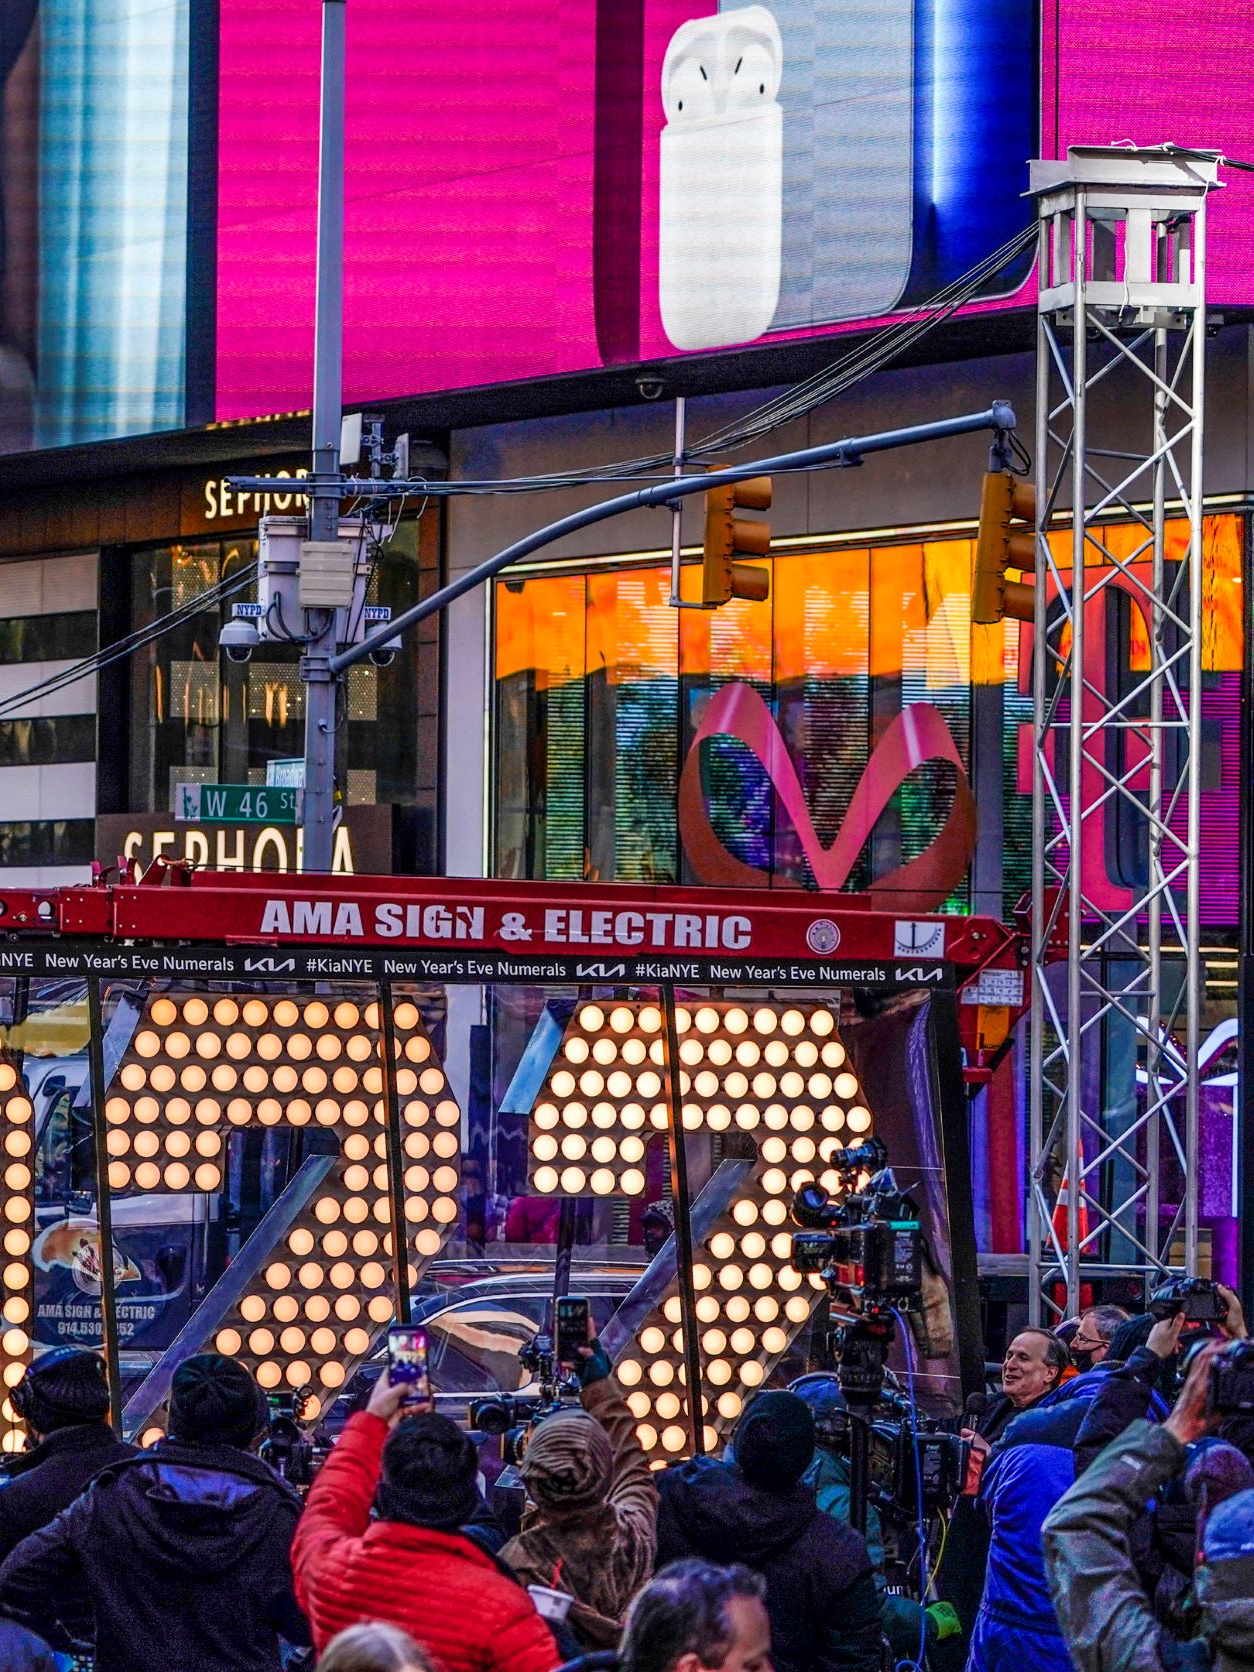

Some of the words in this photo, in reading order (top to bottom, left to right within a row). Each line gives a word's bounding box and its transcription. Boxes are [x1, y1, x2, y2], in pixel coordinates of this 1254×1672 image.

[204, 468, 310, 519] SEPHOR
[237, 605, 262, 616] NYPD
[365, 607, 389, 619] NYPD
[276, 764, 305, 788] Broadwa
[207, 790, 227, 817] W
[239, 791, 268, 818] 46
[280, 792, 295, 809] St
[124, 827, 354, 884] SEPHOA
[260, 900, 364, 936] AMA
[374, 903, 485, 940] SIGN
[499, 912, 533, 941] &
[544, 909, 752, 950] ELECTRIC
[45, 953, 78, 968] New
[83, 954, 128, 969] Year's
[132, 955, 159, 970] Eve
[163, 955, 234, 972] Numerals
[306, 958, 373, 973] #KiaNYE
[384, 960, 417, 974] New
[420, 960, 464, 975] Year's
[467, 961, 494, 975] Eve
[497, 961, 566, 976] Numerals
[635, 963, 699, 978] #KiaNYE
[710, 965, 742, 980] New
[745, 965, 787, 980] Year's
[790, 966, 816, 981] Eve
[819, 966, 886, 982] Numerals
[37, 1304, 64, 1318] AMA
[65, 1304, 92, 1318] SIGN
[115, 1305, 155, 1320] ECTRIC
[58, 1321, 135, 1336] 914.53052
